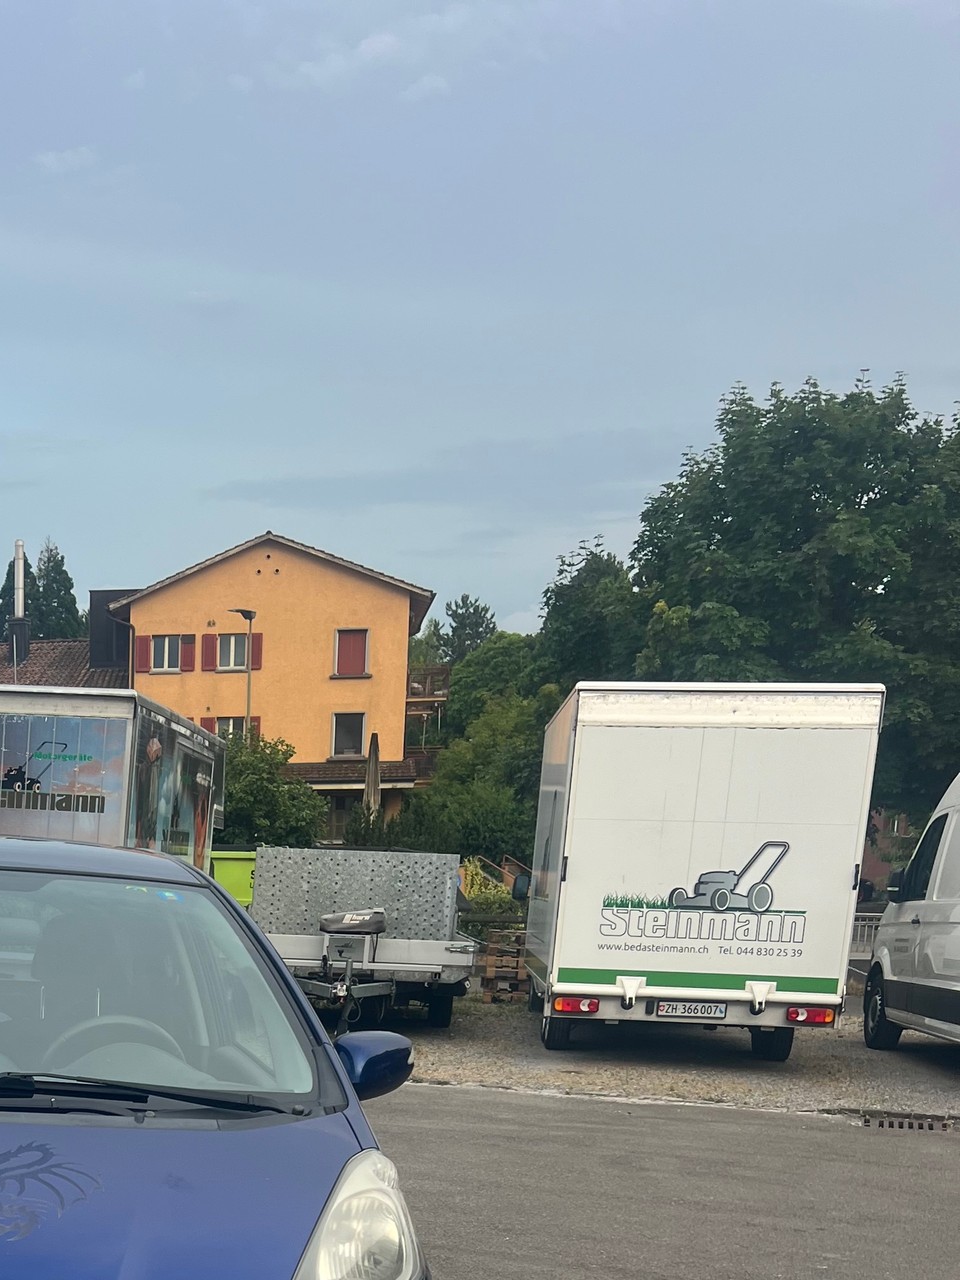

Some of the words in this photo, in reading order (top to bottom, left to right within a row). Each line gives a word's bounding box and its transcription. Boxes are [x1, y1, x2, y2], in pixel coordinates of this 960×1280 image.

[599, 908, 807, 943] Steinmann
[597, 942, 709, 955] www.bedasteinmann.ch
[736, 946, 754, 956] 044
[756, 947, 774, 957] 830
[776, 948, 788, 957] 25
[790, 949, 803, 958] 39
